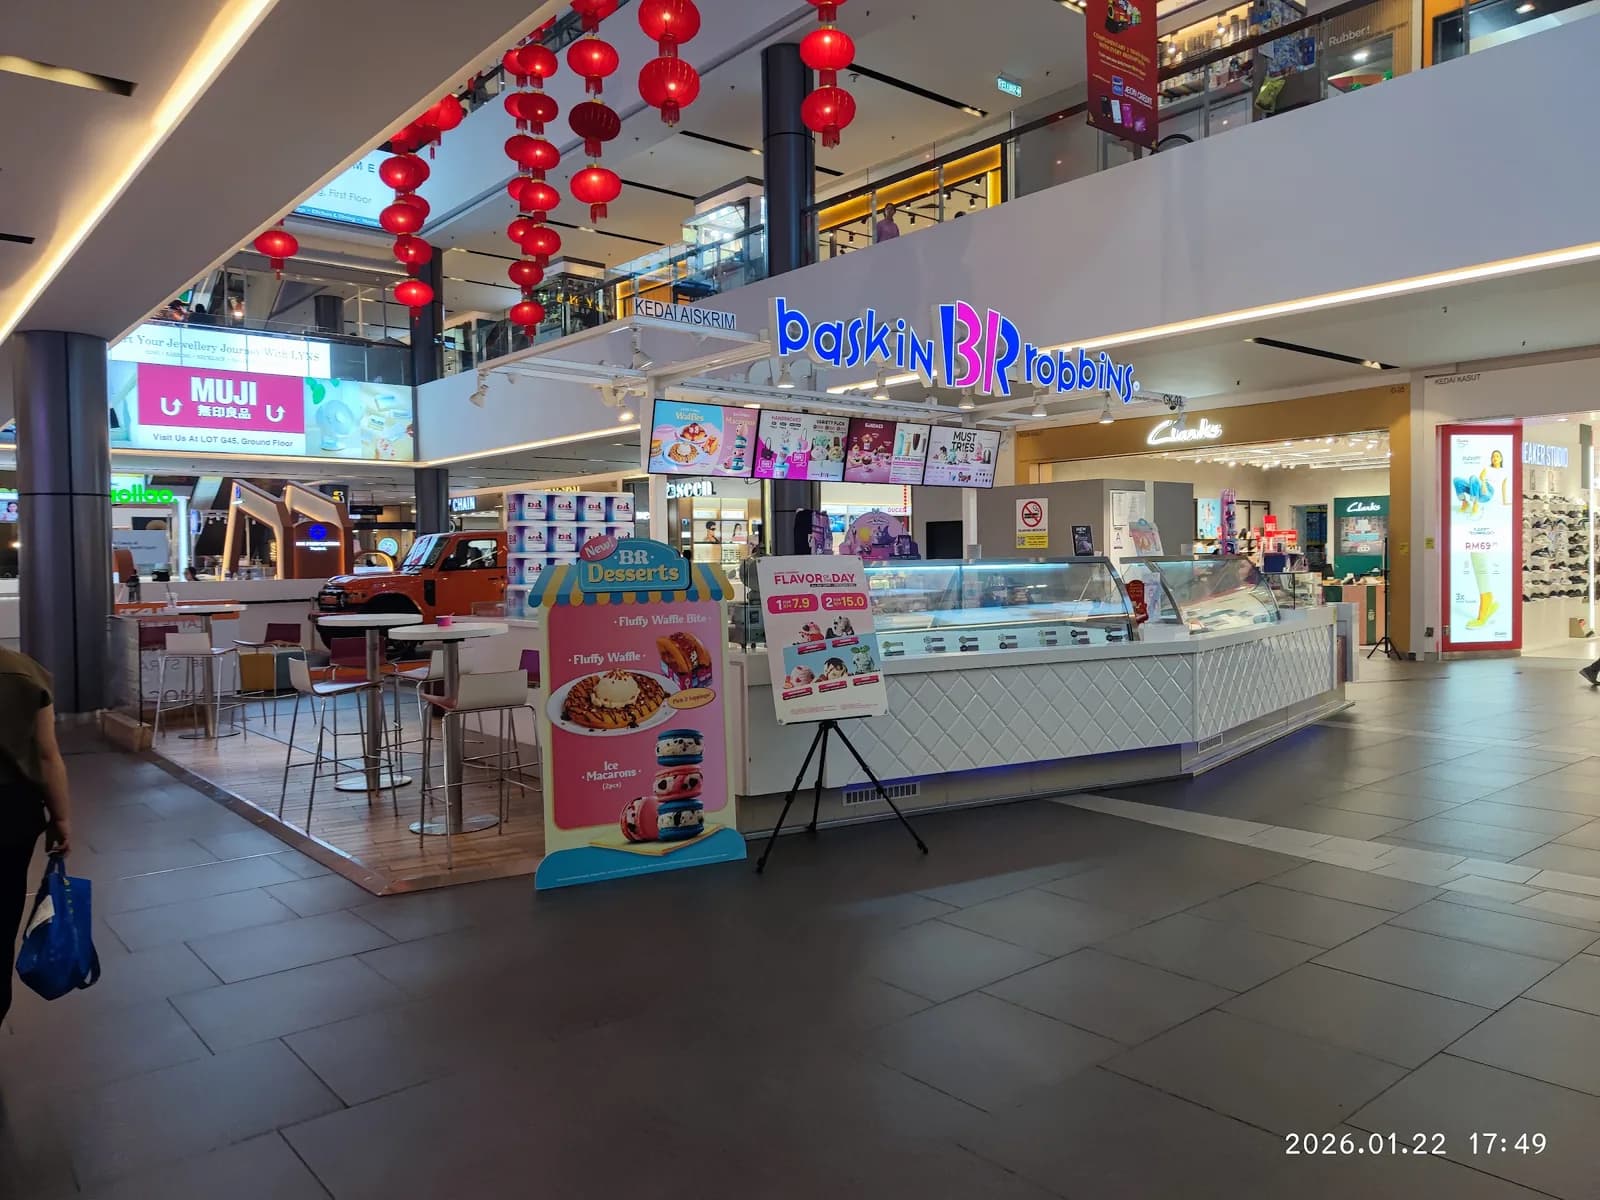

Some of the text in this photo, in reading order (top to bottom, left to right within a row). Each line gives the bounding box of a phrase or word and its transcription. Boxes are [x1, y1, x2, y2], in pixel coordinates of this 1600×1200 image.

[635, 297, 736, 329] KEDAI AISKRIM
[137, 335, 164, 348] Your
[166, 338, 216, 354] Jewellery
[190, 376, 258, 406] MUJI
[197, 404, 252, 420] 無印良品
[153, 432, 172, 442] Visit
[174, 434, 186, 443] Us
[188, 434, 199, 444] At
[200, 435, 218, 444] LOT
[241, 438, 270, 446] Ground
[272, 439, 294, 448] Floor
[953, 432, 978, 442] MUST
[952, 442, 976, 453] TRIES
[452, 496, 476, 512] CHAIN
[1346, 501, 1382, 513] Clarks
[584, 538, 614, 558] New!
[618, 550, 650, 565] BR
[587, 562, 681, 584] Desserts
[774, 573, 822, 586] FLAVOR
[832, 573, 855, 583] DAY
[776, 600, 782, 610] 1
[792, 598, 810, 609] 7.9
[826, 596, 833, 608] 2
[841, 596, 864, 607] 15.0
[618, 613, 707, 628] Fluffy Waffle Bite
[573, 652, 641, 666] Fluffy Waffle
[604, 761, 619, 771] Ice
[586, 769, 637, 782] Macarons
